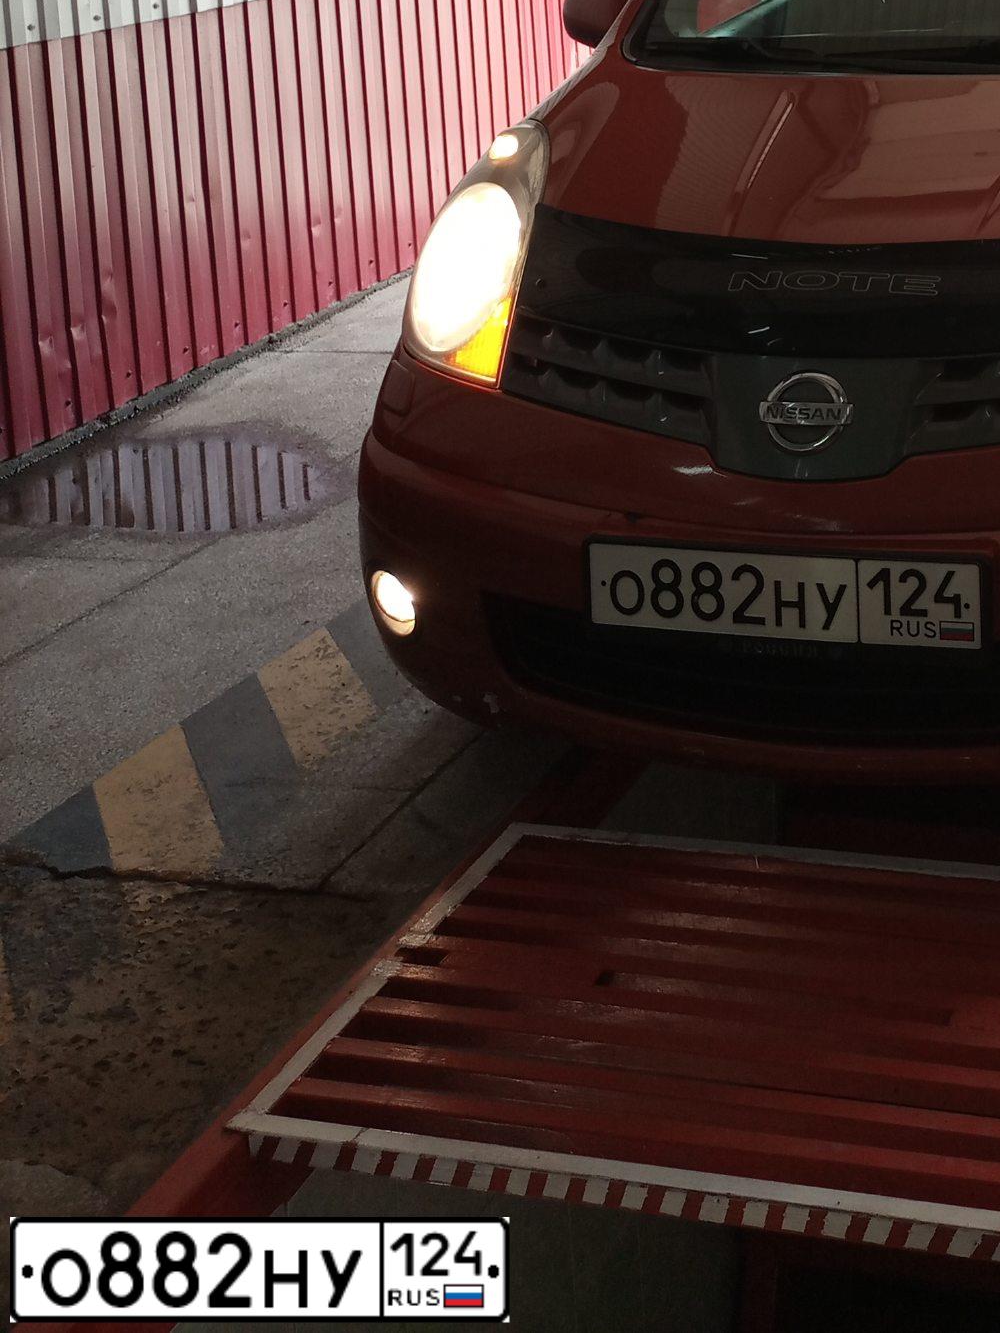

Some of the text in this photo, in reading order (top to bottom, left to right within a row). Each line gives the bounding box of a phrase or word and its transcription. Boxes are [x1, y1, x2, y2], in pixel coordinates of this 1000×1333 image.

[727, 270, 941, 296] NOTE
[766, 403, 842, 421] NISSAN
[866, 567, 962, 619] 124
[889, 619, 938, 639] RUS
